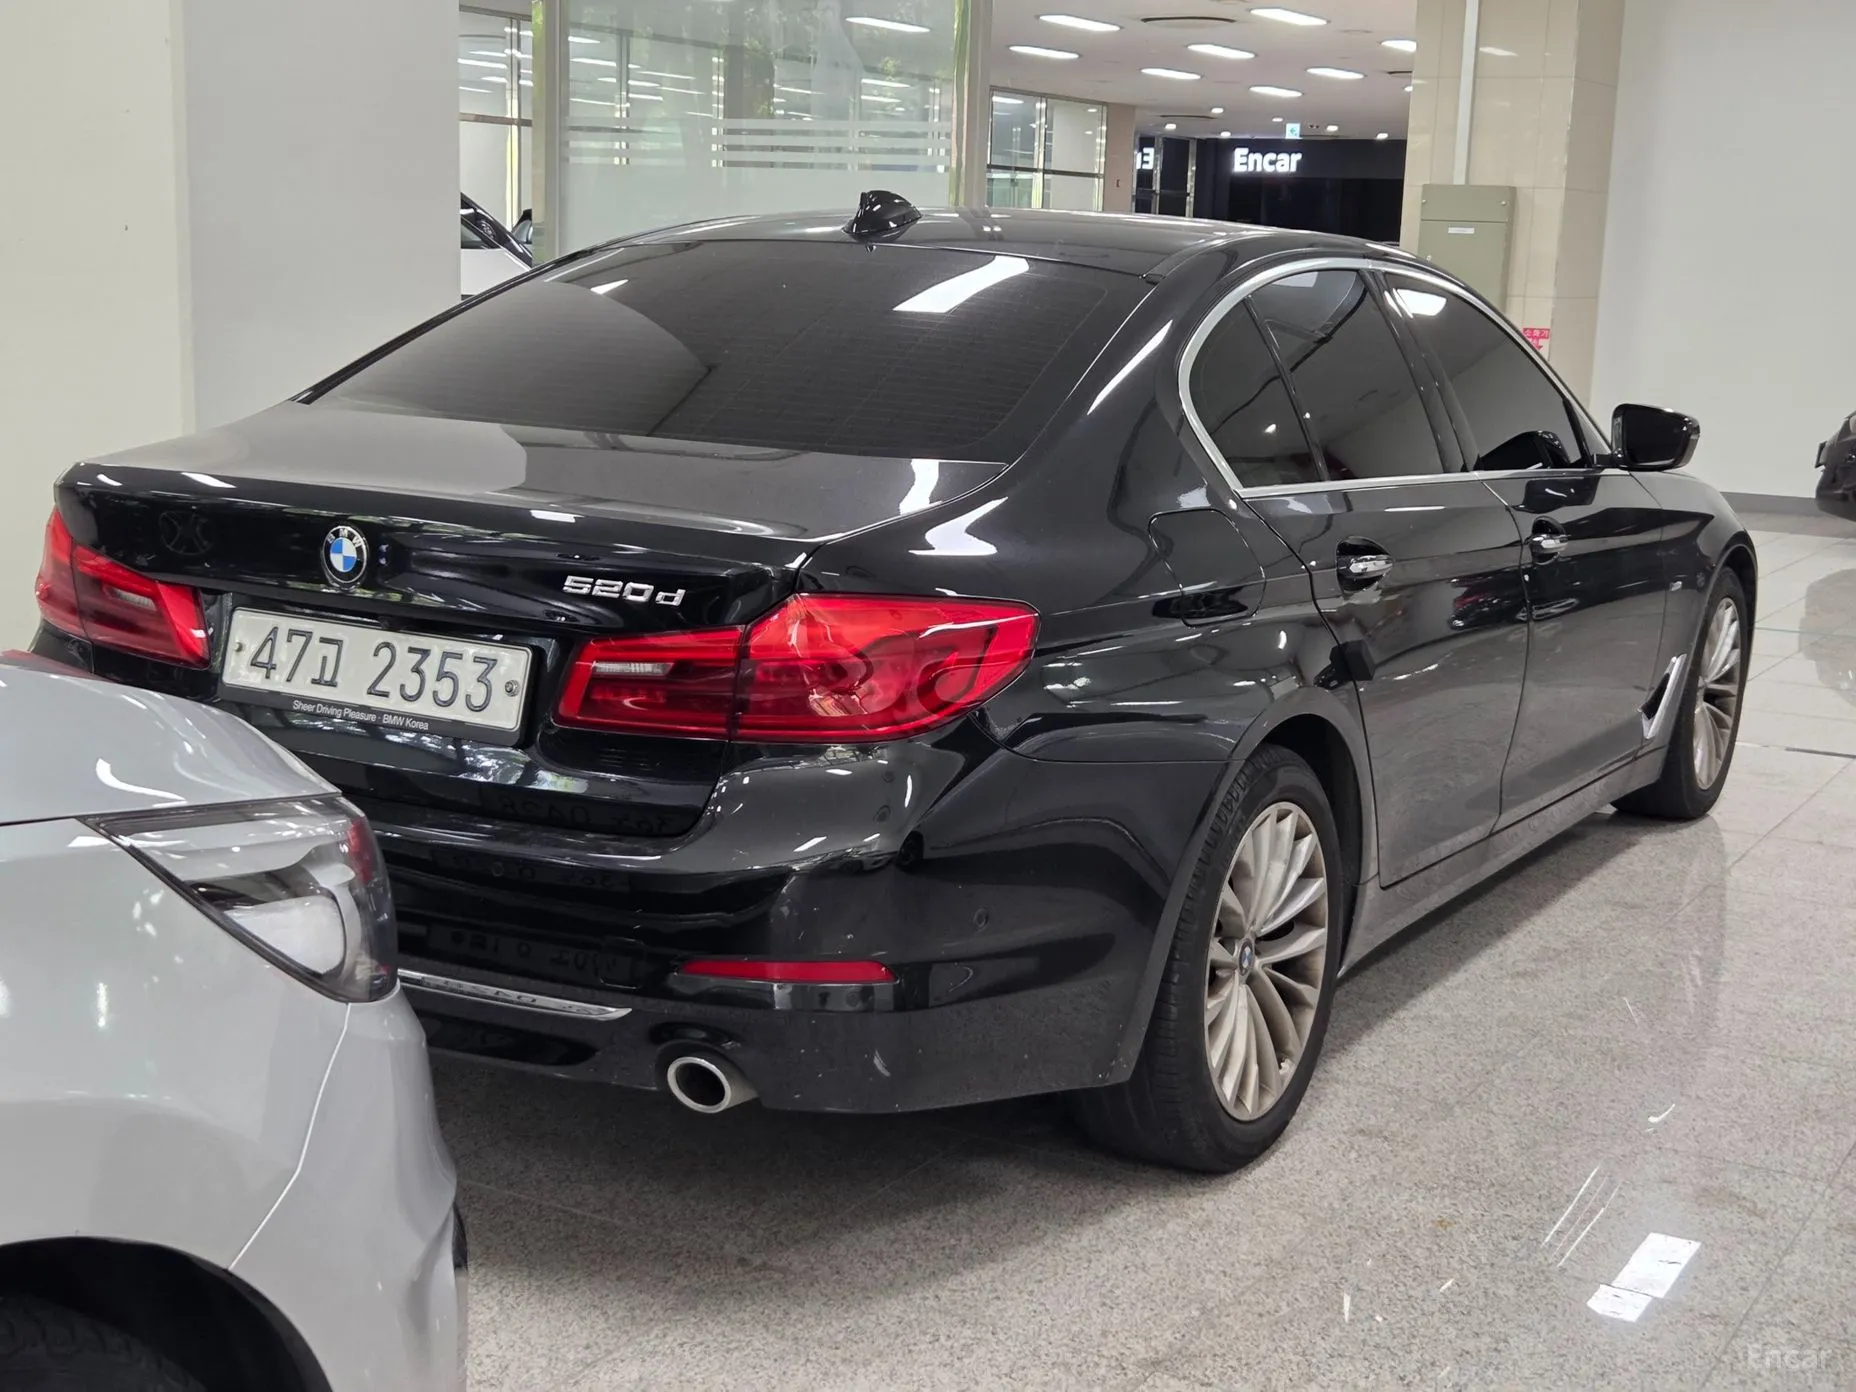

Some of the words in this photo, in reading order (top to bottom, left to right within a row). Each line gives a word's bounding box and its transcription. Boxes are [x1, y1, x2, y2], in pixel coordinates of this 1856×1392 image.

[1234, 147, 1303, 172] Encar
[562, 575, 686, 606] 520d
[250, 626, 344, 688] 47고
[366, 641, 498, 712] 2353
[292, 700, 315, 712] Sheer
[316, 703, 342, 718] Driving
[343, 707, 377, 722] Pleasure
[382, 714, 405, 726] BMW
[405, 718, 429, 731] Korea
